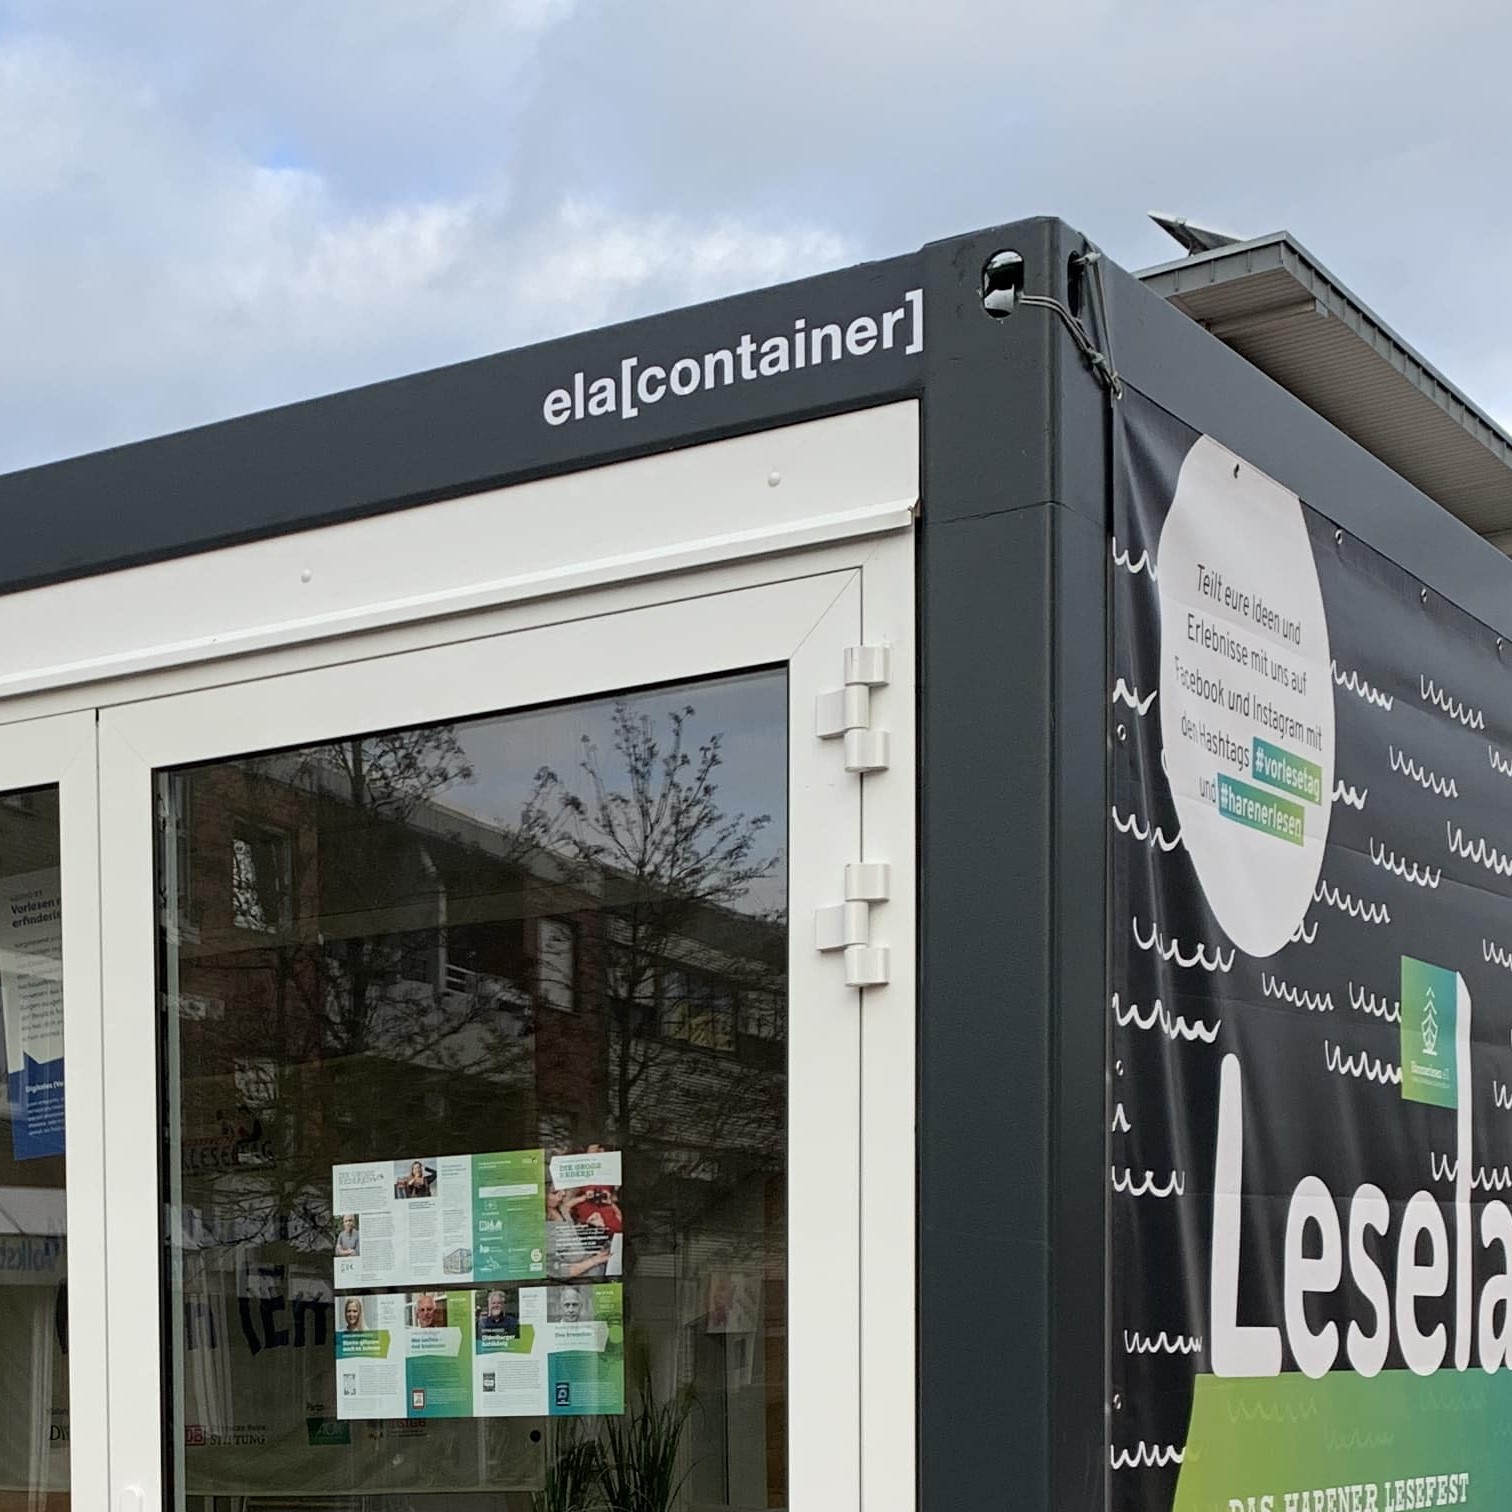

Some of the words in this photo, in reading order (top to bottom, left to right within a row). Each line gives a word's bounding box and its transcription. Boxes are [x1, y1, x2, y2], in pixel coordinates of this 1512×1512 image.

[542, 288, 924, 427] ela[container]
[1196, 563, 1223, 603] Teilt
[1225, 587, 1250, 616] eure
[1252, 594, 1281, 634] Ideen
[1282, 615, 1302, 646] und
[1187, 612, 1248, 666] Erlebnisse
[1251, 646, 1269, 678] mit
[1270, 660, 1290, 687] uns
[1291, 669, 1308, 696] auf
[1174, 655, 1226, 707] Facebook
[1228, 687, 1251, 718] und
[1253, 693, 1305, 743] Instagram
[1306, 717, 1323, 751] mit
[1180, 710, 1199, 740] den
[1199, 719, 1250, 768] Hashtags
[1254, 746, 1322, 803] #vorlesetag
[1199, 775, 1217, 804] und
[1219, 783, 1303, 840] #harenerlesen
[1383, 1472, 1470, 1512] LESEFEST
